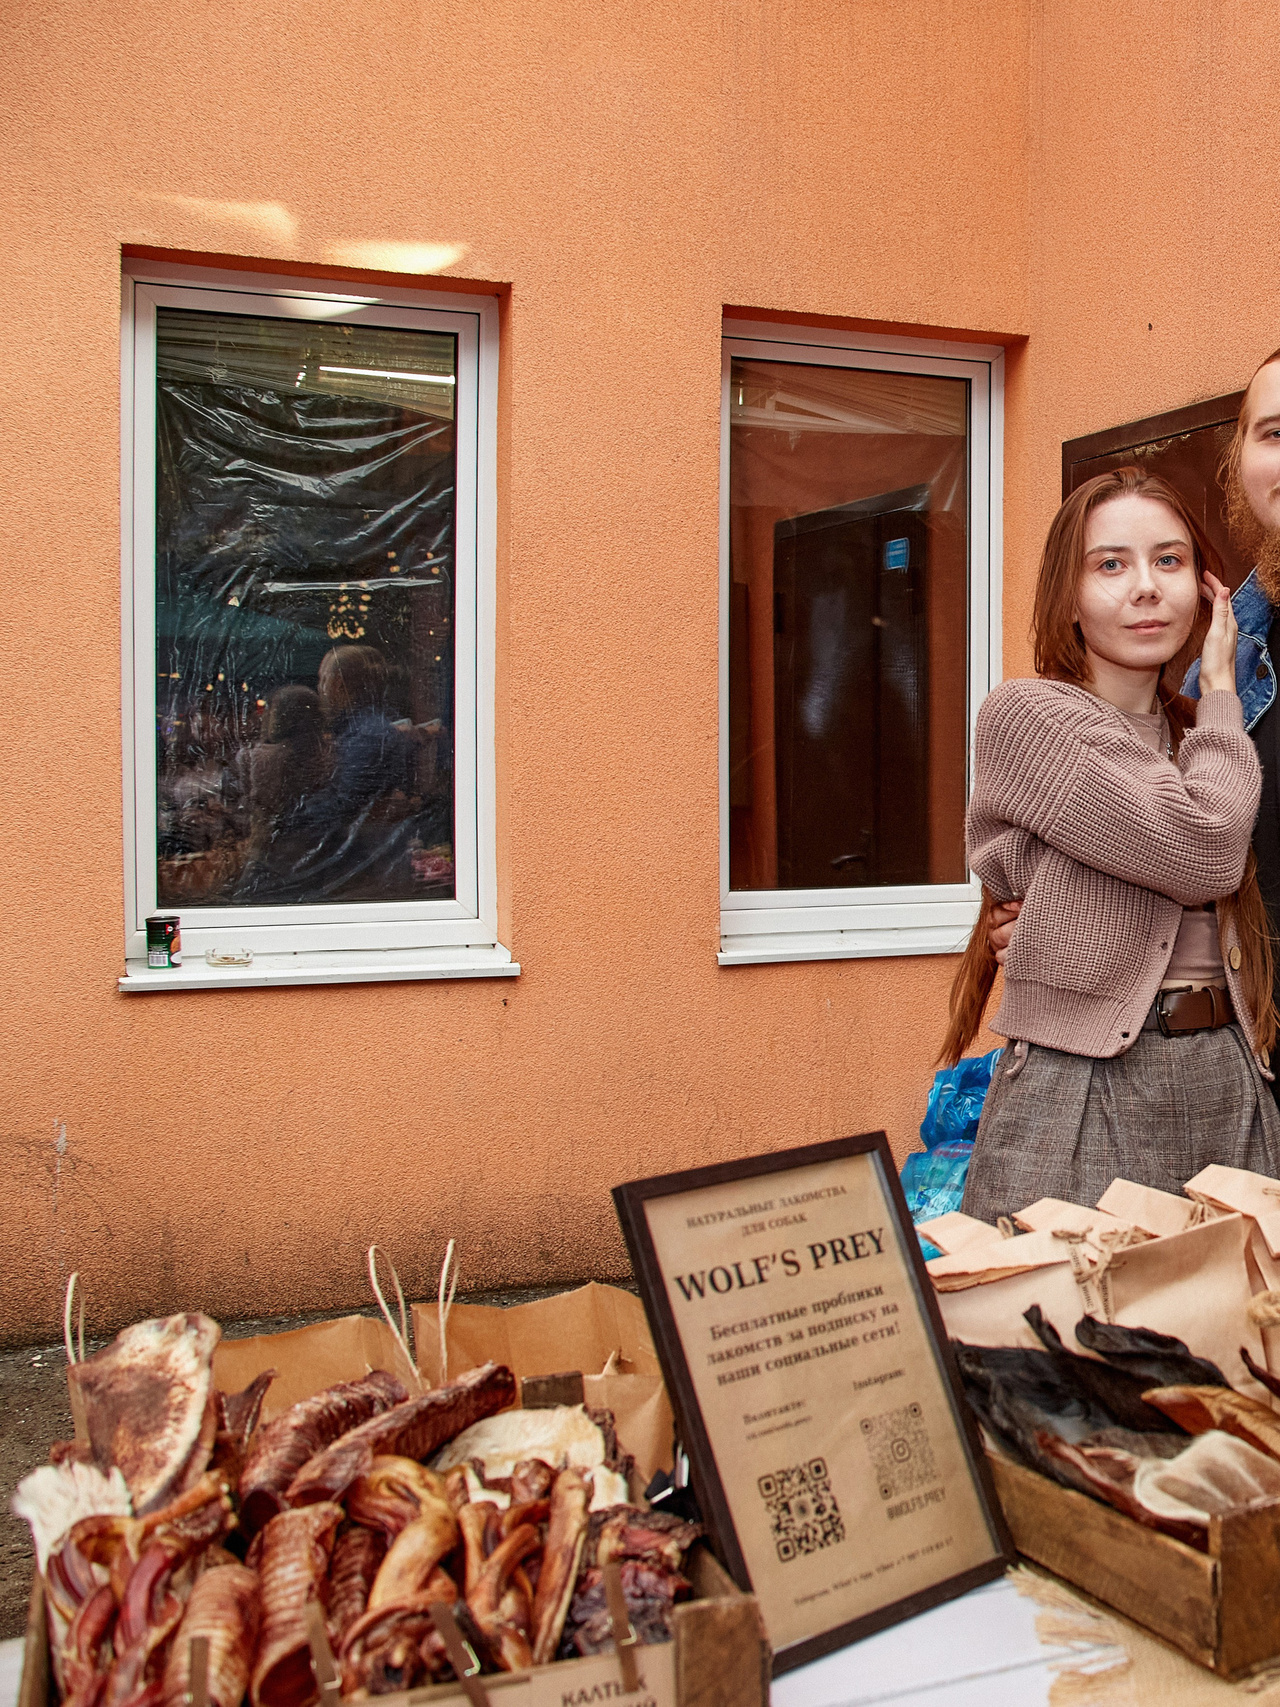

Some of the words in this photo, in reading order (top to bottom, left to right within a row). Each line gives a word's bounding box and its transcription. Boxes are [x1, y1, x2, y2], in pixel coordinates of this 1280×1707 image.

[686, 1200, 775, 1229] НАТУРАЛЬНЫЕ
[779, 1185, 848, 1209] ЛАКОМСТВА
[741, 1221, 767, 1237] ДЛЯ
[768, 1212, 808, 1229] СОБАК
[674, 1249, 802, 1302] WOLF'S
[807, 1228, 886, 1270] PREY
[707, 1335, 783, 1366] лакомств
[787, 1328, 804, 1342] за
[807, 1307, 878, 1337] подписку
[881, 1302, 900, 1317] на
[709, 1304, 808, 1341] Бесплатные
[811, 1285, 884, 1314] пробники
[716, 1363, 761, 1387] наши
[765, 1335, 860, 1372] социальные
[862, 1320, 902, 1344] сети!
